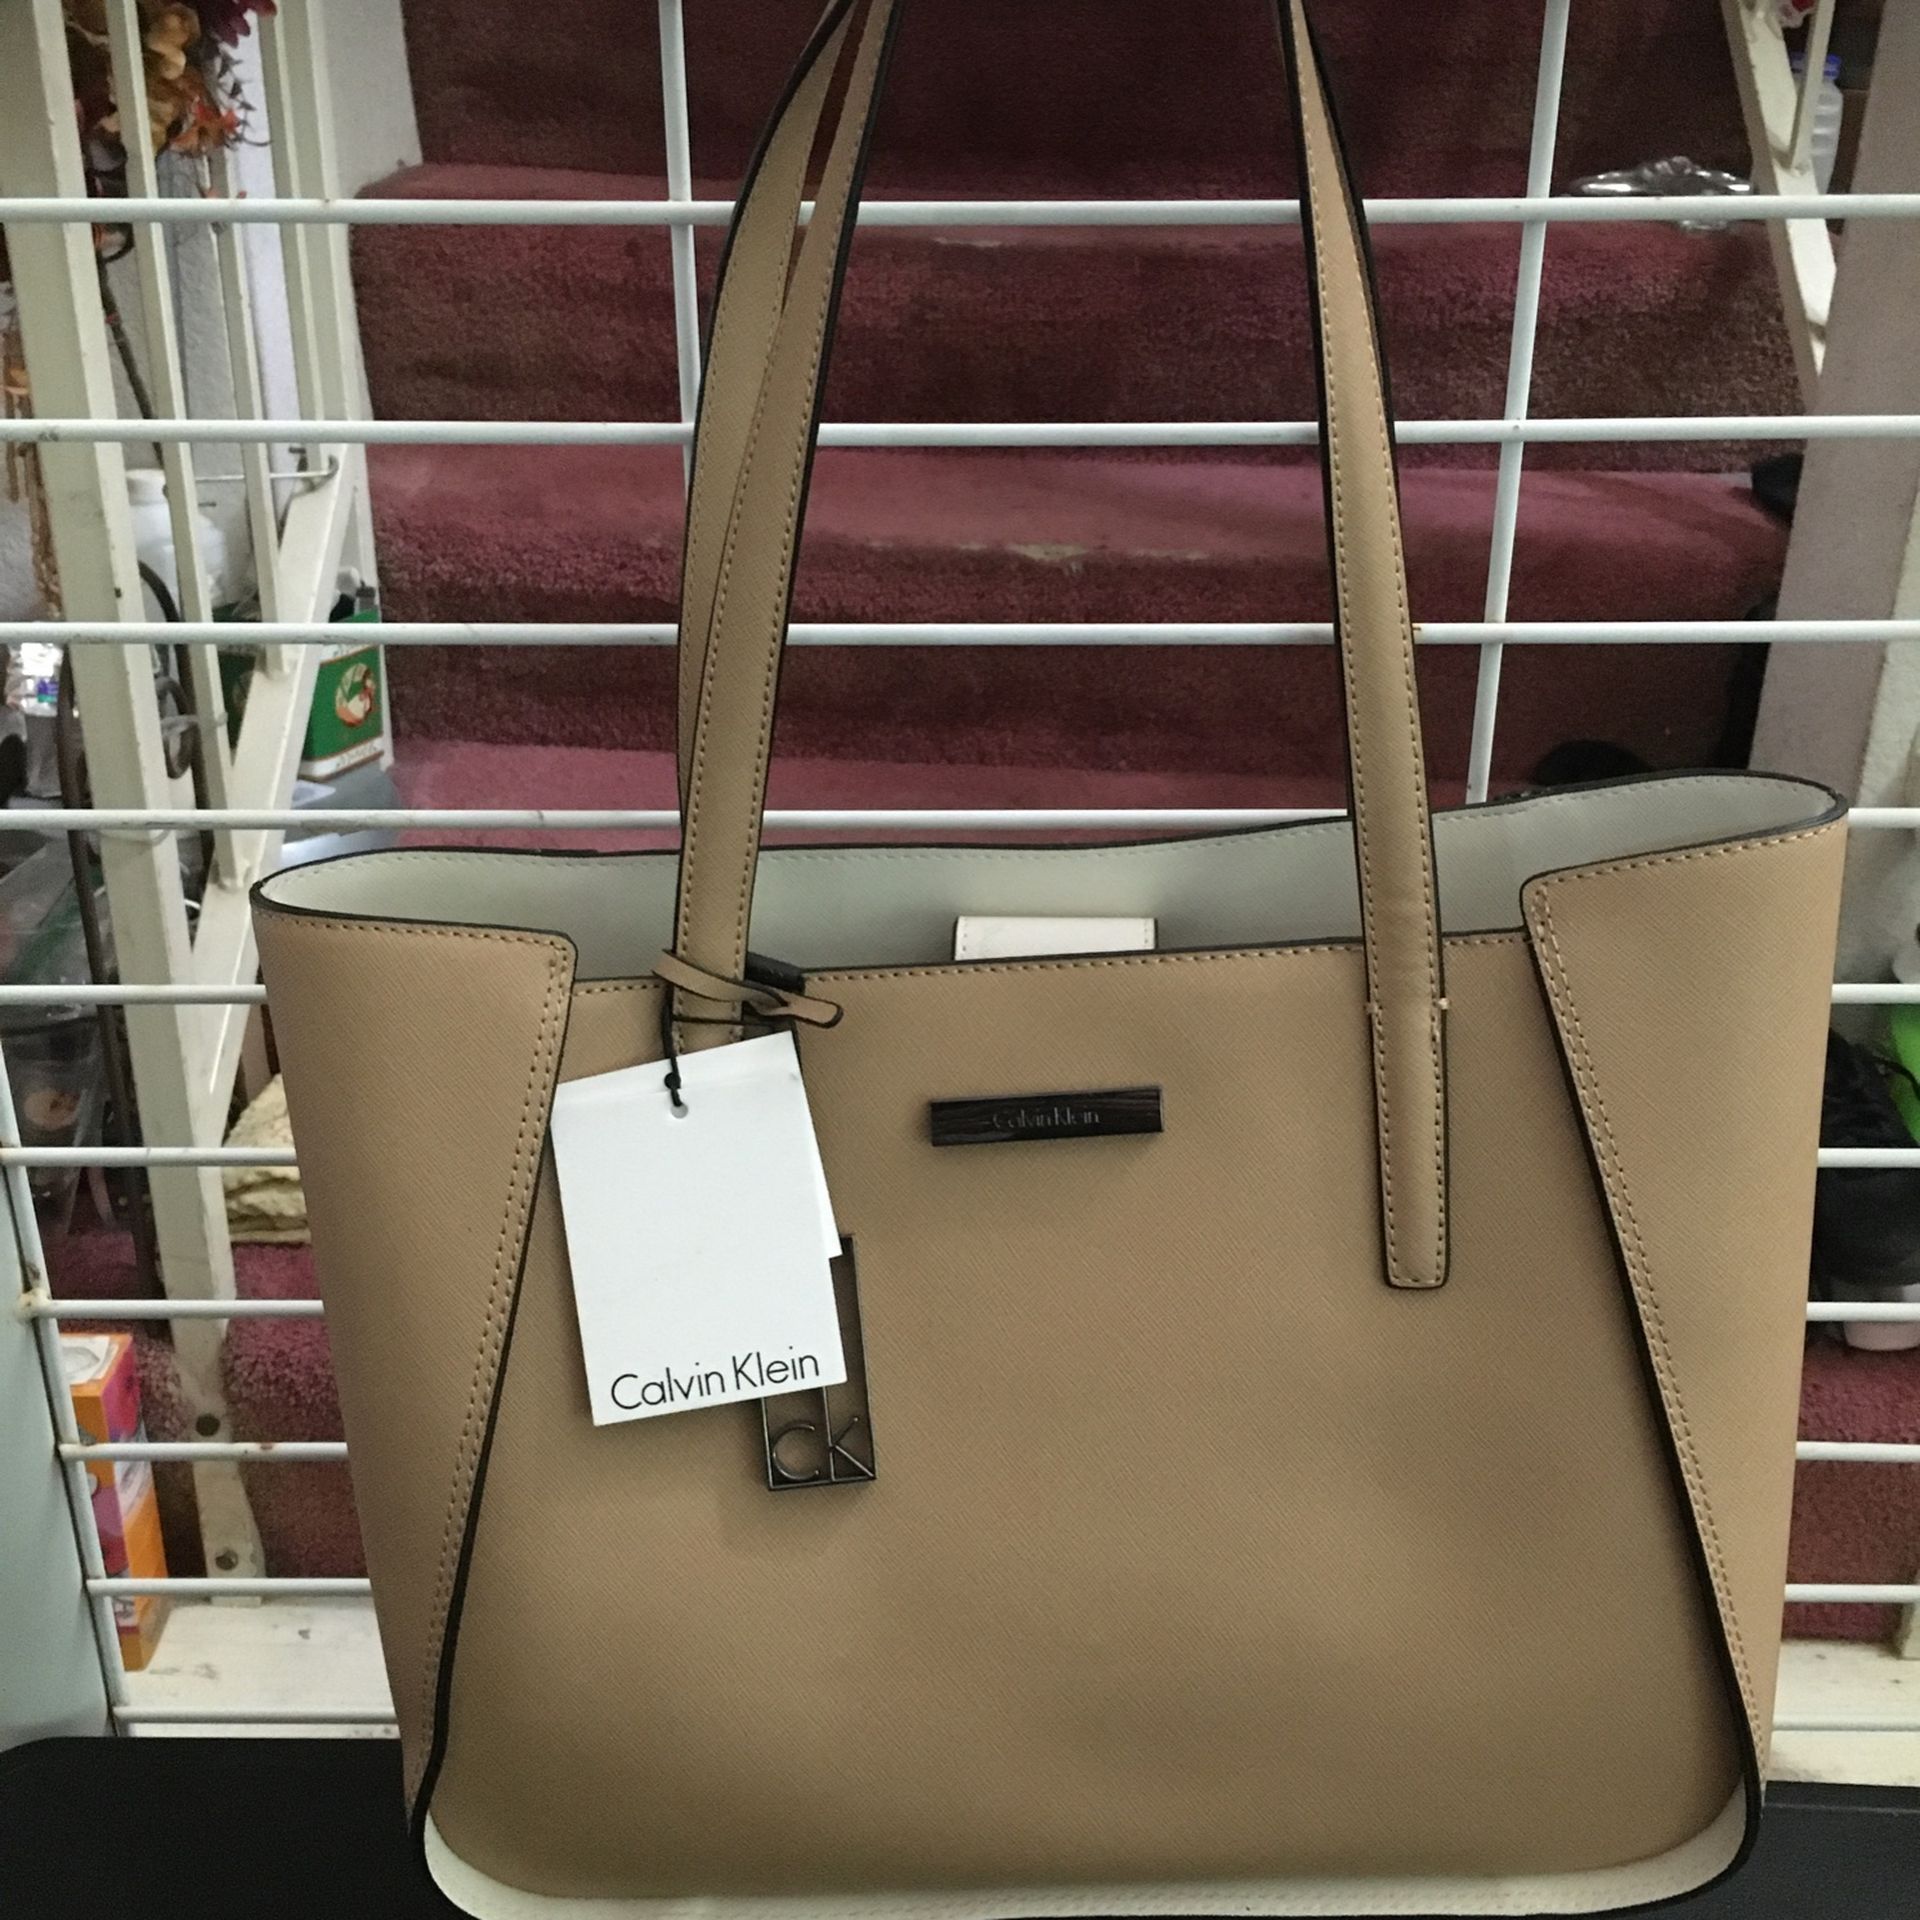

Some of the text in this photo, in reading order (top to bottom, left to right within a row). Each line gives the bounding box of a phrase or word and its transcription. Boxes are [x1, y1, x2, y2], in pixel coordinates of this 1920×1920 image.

[611, 1346, 820, 1410] Calvin Klein
[772, 1414, 875, 1481] CK
